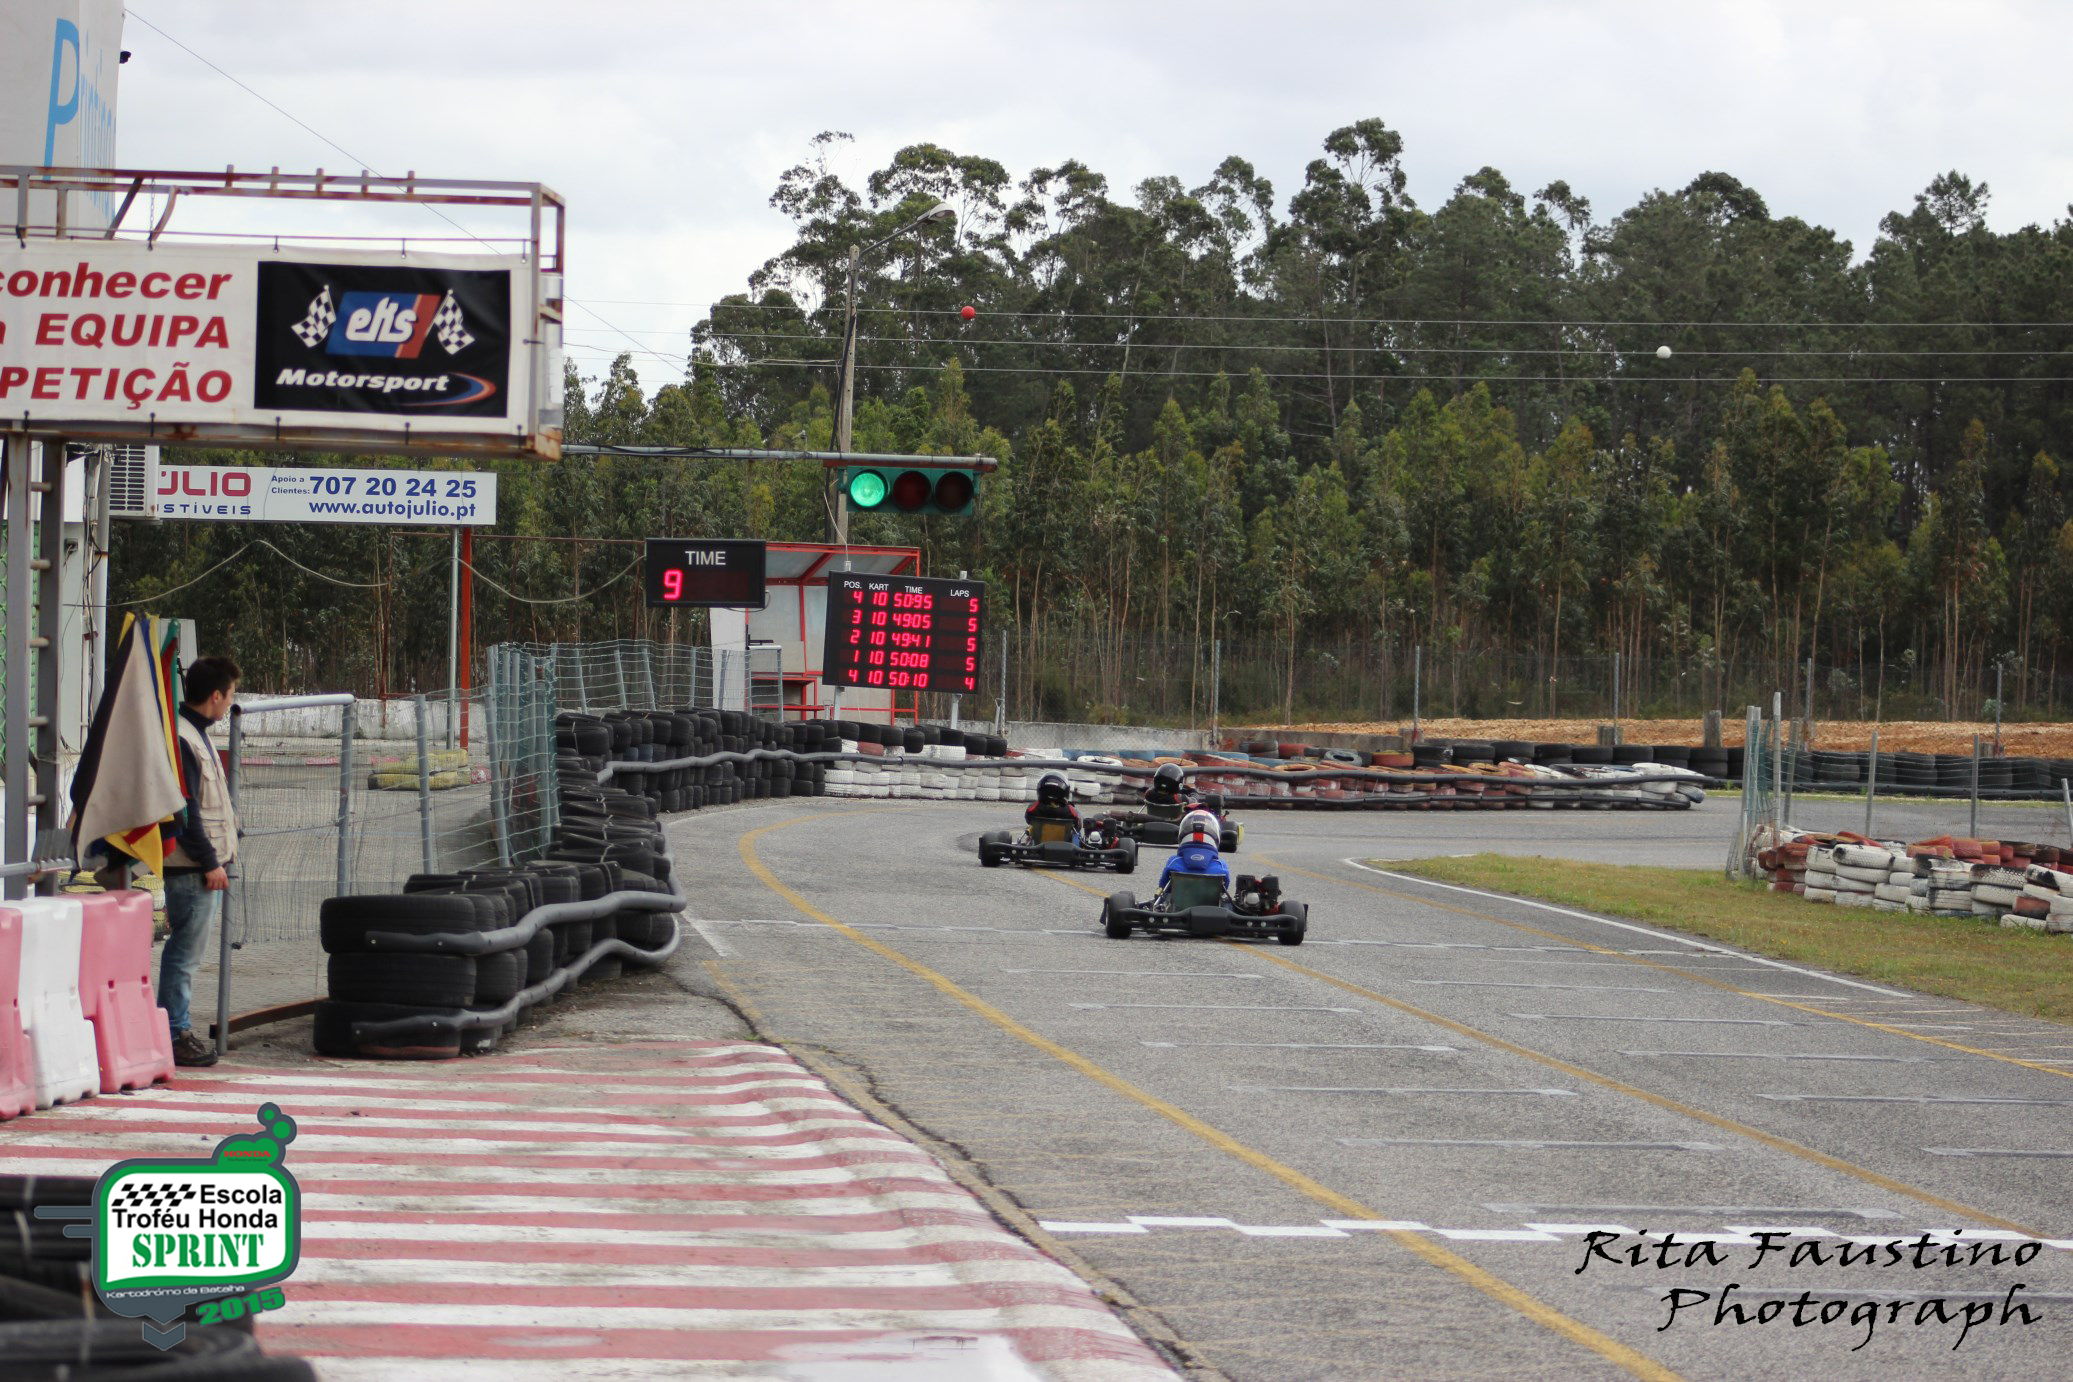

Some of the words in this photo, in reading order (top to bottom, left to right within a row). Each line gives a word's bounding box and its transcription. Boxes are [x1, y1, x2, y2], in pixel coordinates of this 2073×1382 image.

[0, 262, 233, 300] onhecer
[35, 313, 229, 349] EQUIPA
[276, 368, 449, 393] Motorsport
[271, 474, 297, 483] Apoio
[309, 476, 357, 495] 707
[365, 477, 397, 496] 20
[405, 478, 437, 497] 24
[445, 479, 477, 498] 25
[271, 486, 311, 495] Clientes:
[157, 502, 252, 515] STÍVEIS
[308, 499, 477, 520] www.autojulio.pt
[684, 550, 727, 566] TIME
[663, 569, 684, 600] 9
[843, 580, 863, 590] POS.
[868, 582, 889, 591] KART
[904, 585, 923, 594] TIME
[950, 588, 970, 597] LAPS
[853, 591, 863, 604] 4
[872, 592, 889, 606] 10
[969, 598, 979, 613] 5
[851, 609, 863, 625] 3
[871, 611, 888, 626] 10
[967, 617, 978, 633] 5
[849, 629, 862, 644] 2
[869, 631, 887, 646] 10
[966, 636, 977, 652] 5
[853, 649, 860, 663] 1
[869, 650, 886, 665] 10
[965, 656, 976, 671] 5
[848, 669, 859, 683] 4
[867, 670, 884, 685] 10
[964, 677, 975, 690] 4
